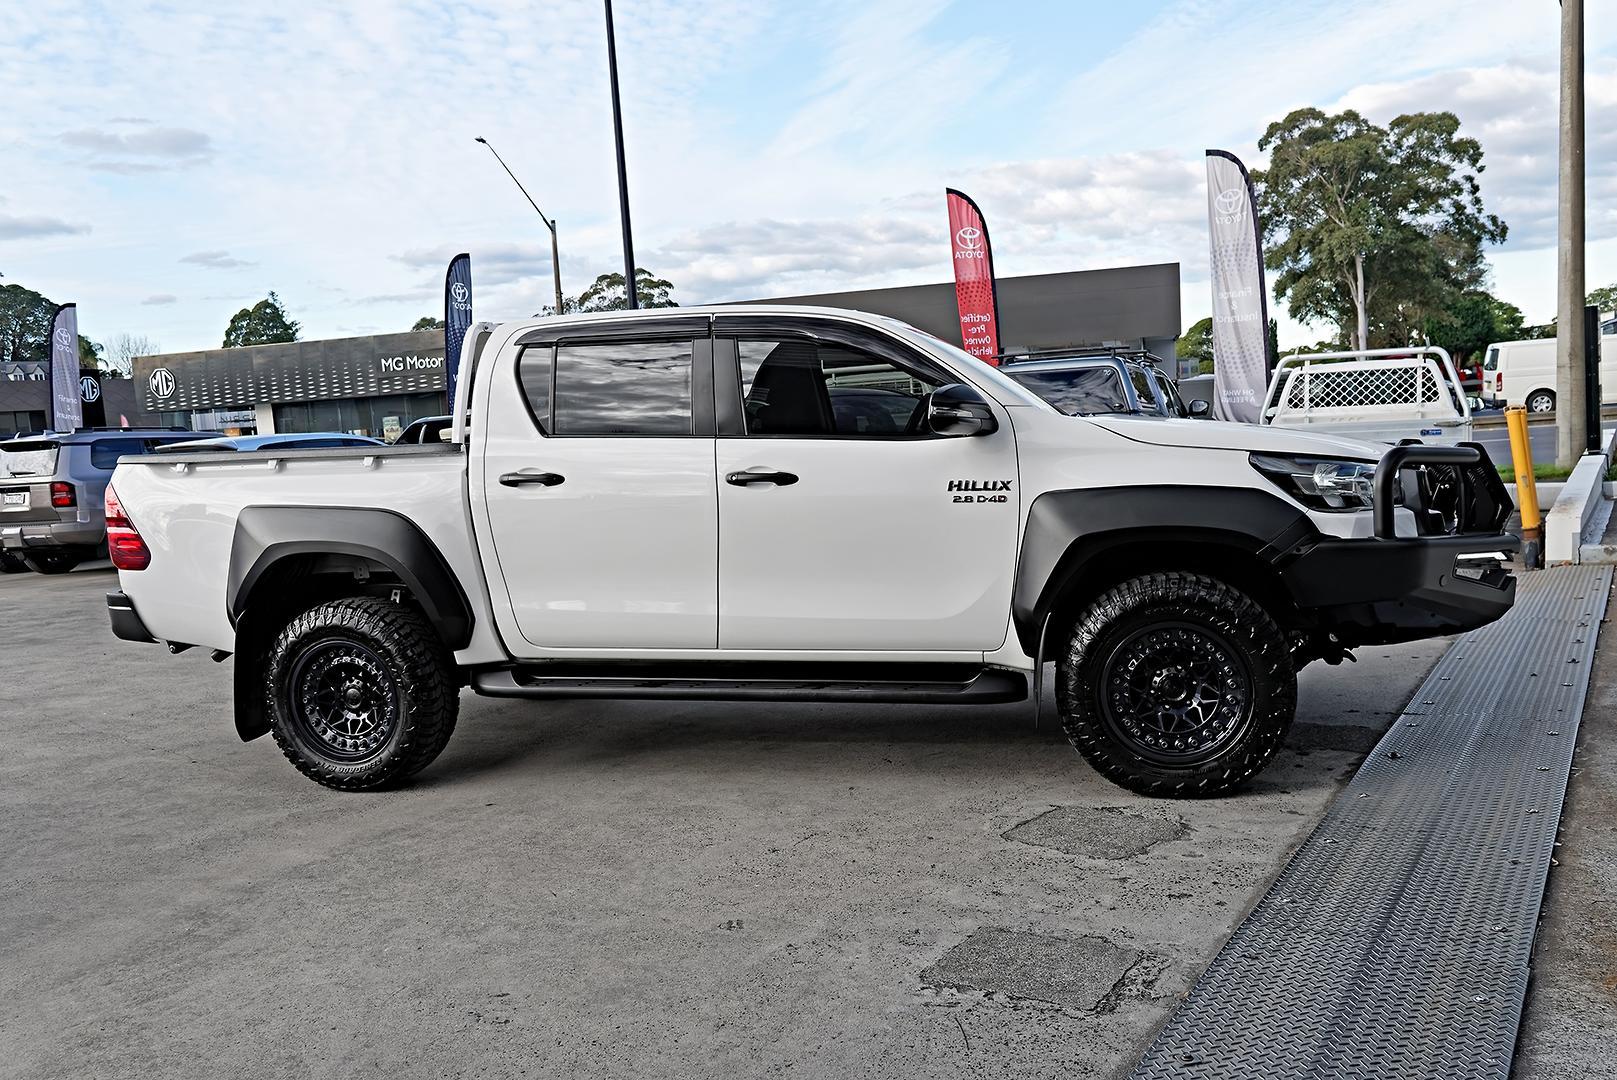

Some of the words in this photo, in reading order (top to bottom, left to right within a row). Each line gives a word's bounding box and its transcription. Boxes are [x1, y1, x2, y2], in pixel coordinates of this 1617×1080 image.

[381, 357, 404, 372] MG
[406, 355, 444, 371] Motor
[80, 378, 98, 401] MG
[150, 369, 175, 397] MG
[947, 479, 1013, 492] HILUX
[952, 495, 974, 504] 2.8
[976, 495, 1008, 504] D-4D
